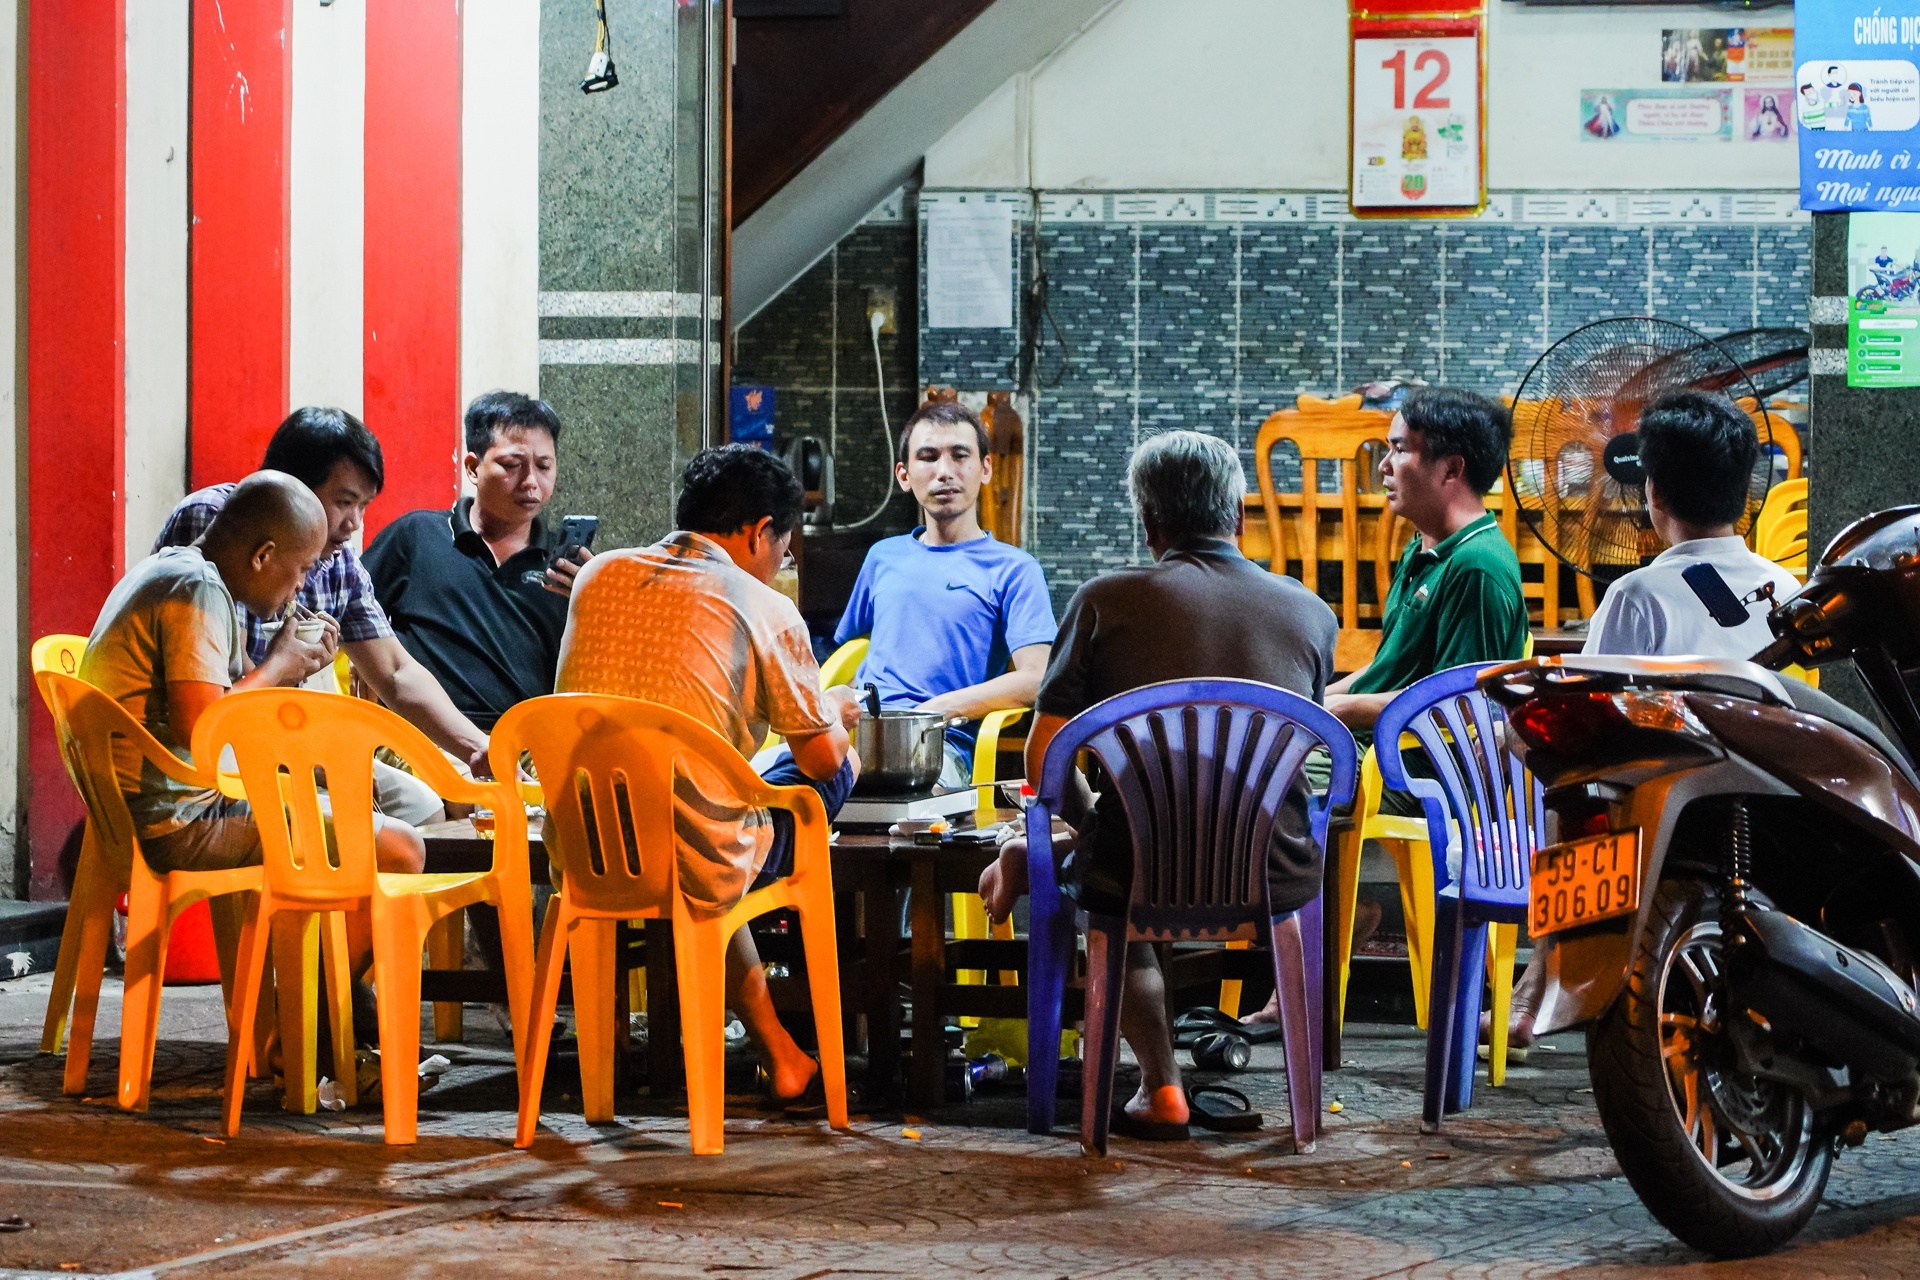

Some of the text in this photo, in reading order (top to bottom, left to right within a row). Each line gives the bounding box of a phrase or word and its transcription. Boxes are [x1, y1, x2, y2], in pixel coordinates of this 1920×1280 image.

[1853, 6, 1898, 45] CHỐNG
[1381, 48, 1450, 109] 12
[1890, 149, 1914, 170] vì
[1816, 180, 1872, 206] Mọi
[1547, 838, 1619, 887] 59-C1
[1536, 874, 1631, 928] 306.09
